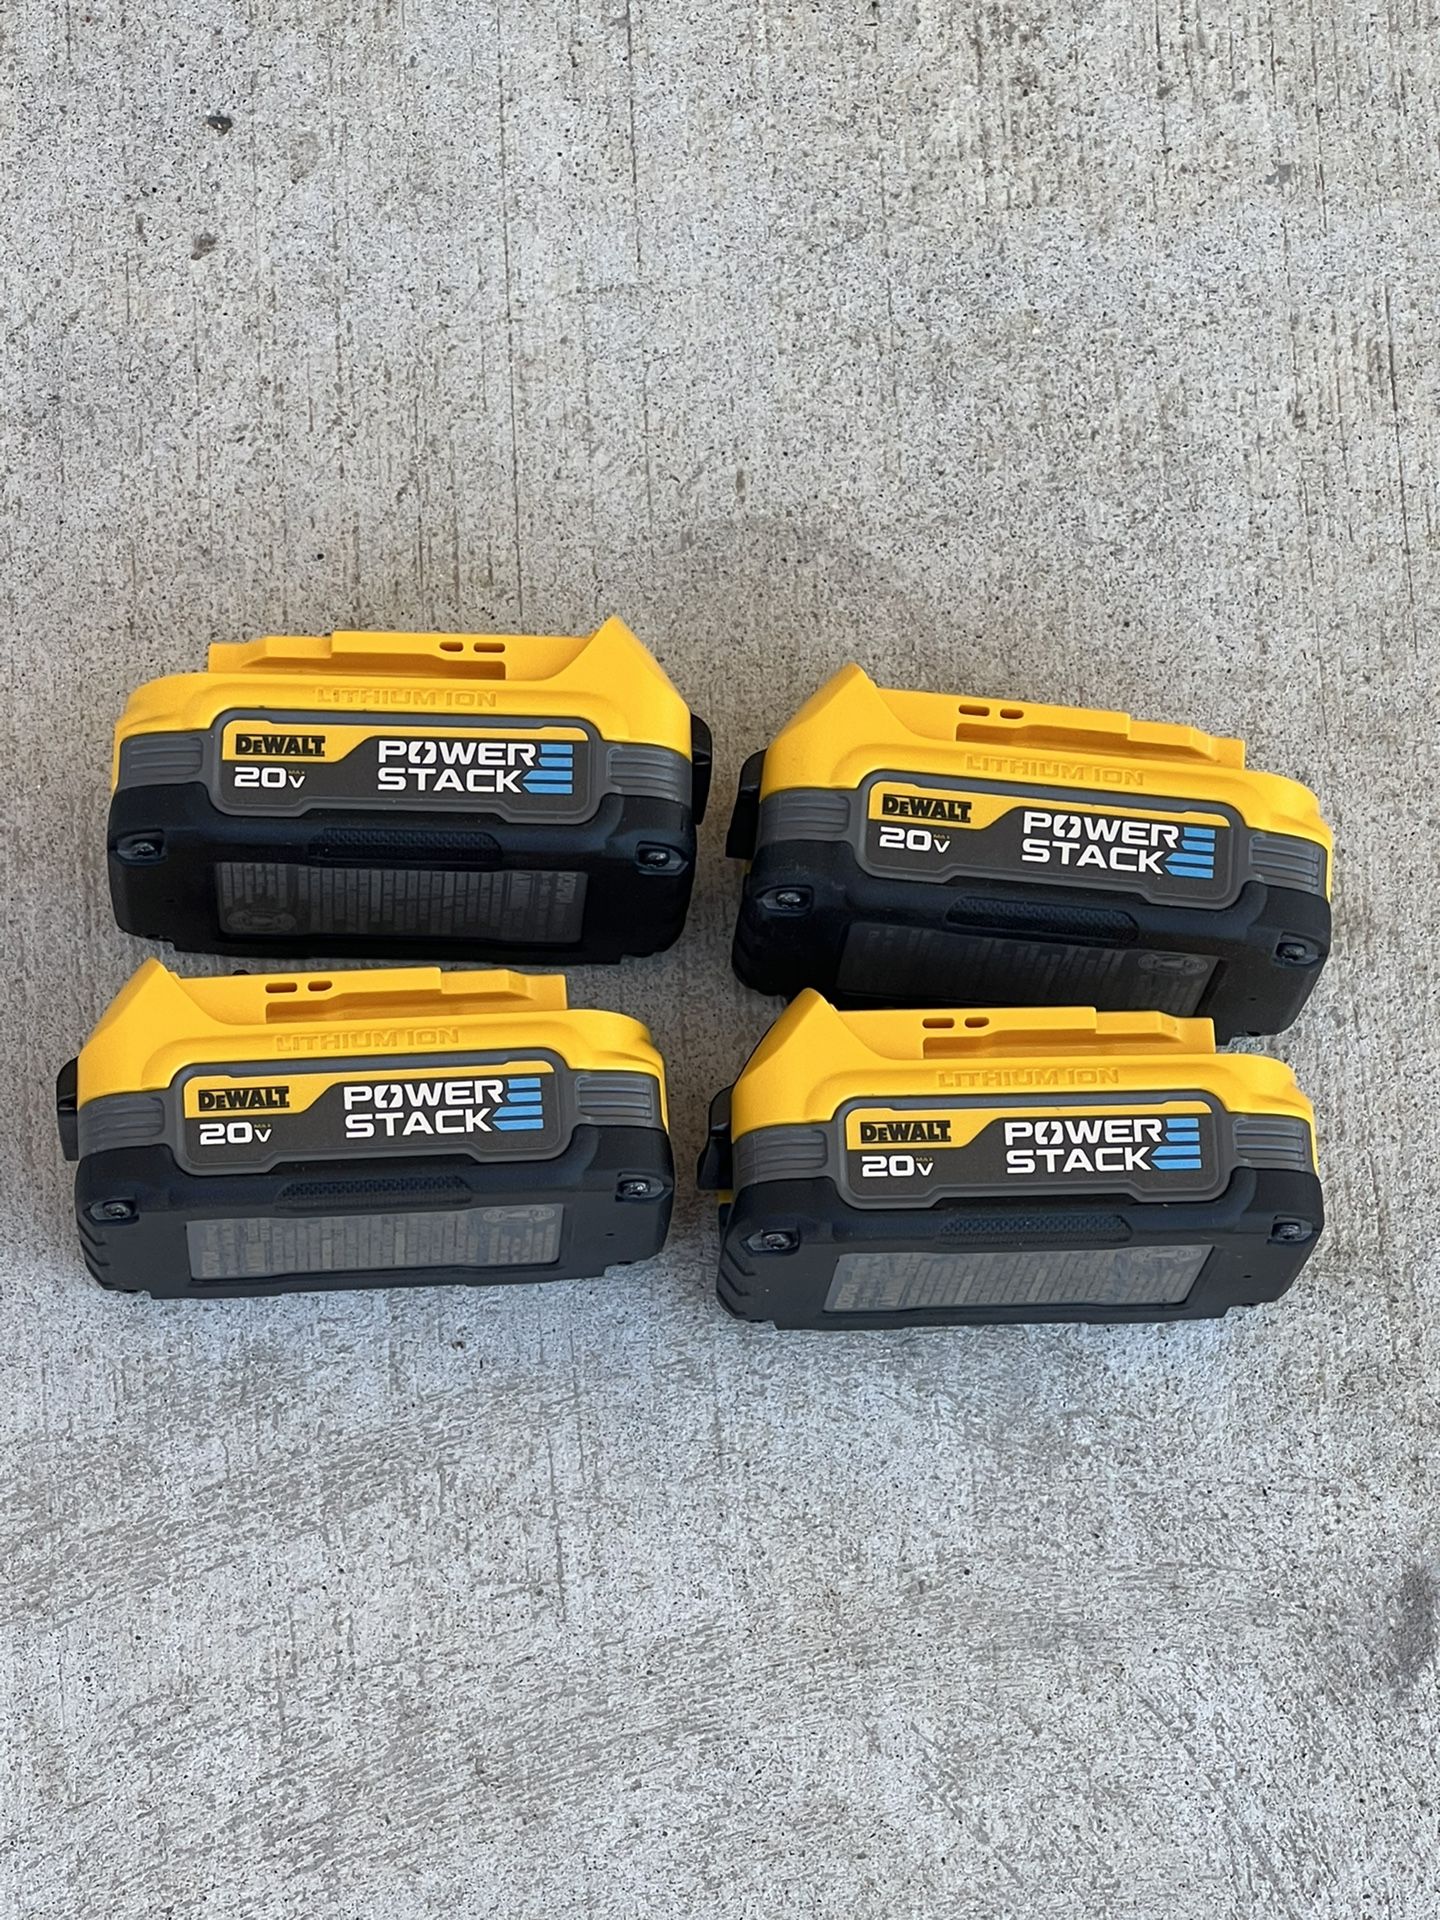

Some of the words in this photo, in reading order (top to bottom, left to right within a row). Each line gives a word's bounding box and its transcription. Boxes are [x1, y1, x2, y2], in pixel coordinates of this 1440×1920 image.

[317, 688, 439, 706] LITHIUM
[446, 689, 497, 708] ION
[378, 740, 537, 767] POWER
[377, 768, 522, 794] STACK
[966, 754, 1086, 783] LITHIUM
[1093, 767, 1145, 787] ION
[1023, 811, 1180, 849] POWER
[1022, 839, 1166, 875] STACK
[276, 1028, 398, 1052] LITHIUM
[406, 1027, 459, 1046] ION
[937, 1067, 1060, 1088] LITHIUM
[1068, 1066, 1120, 1086] ION
[343, 1079, 504, 1111] POWER
[345, 1107, 493, 1139] STACK
[1004, 1118, 1163, 1147] POWER
[1006, 1146, 1152, 1174] STACK
